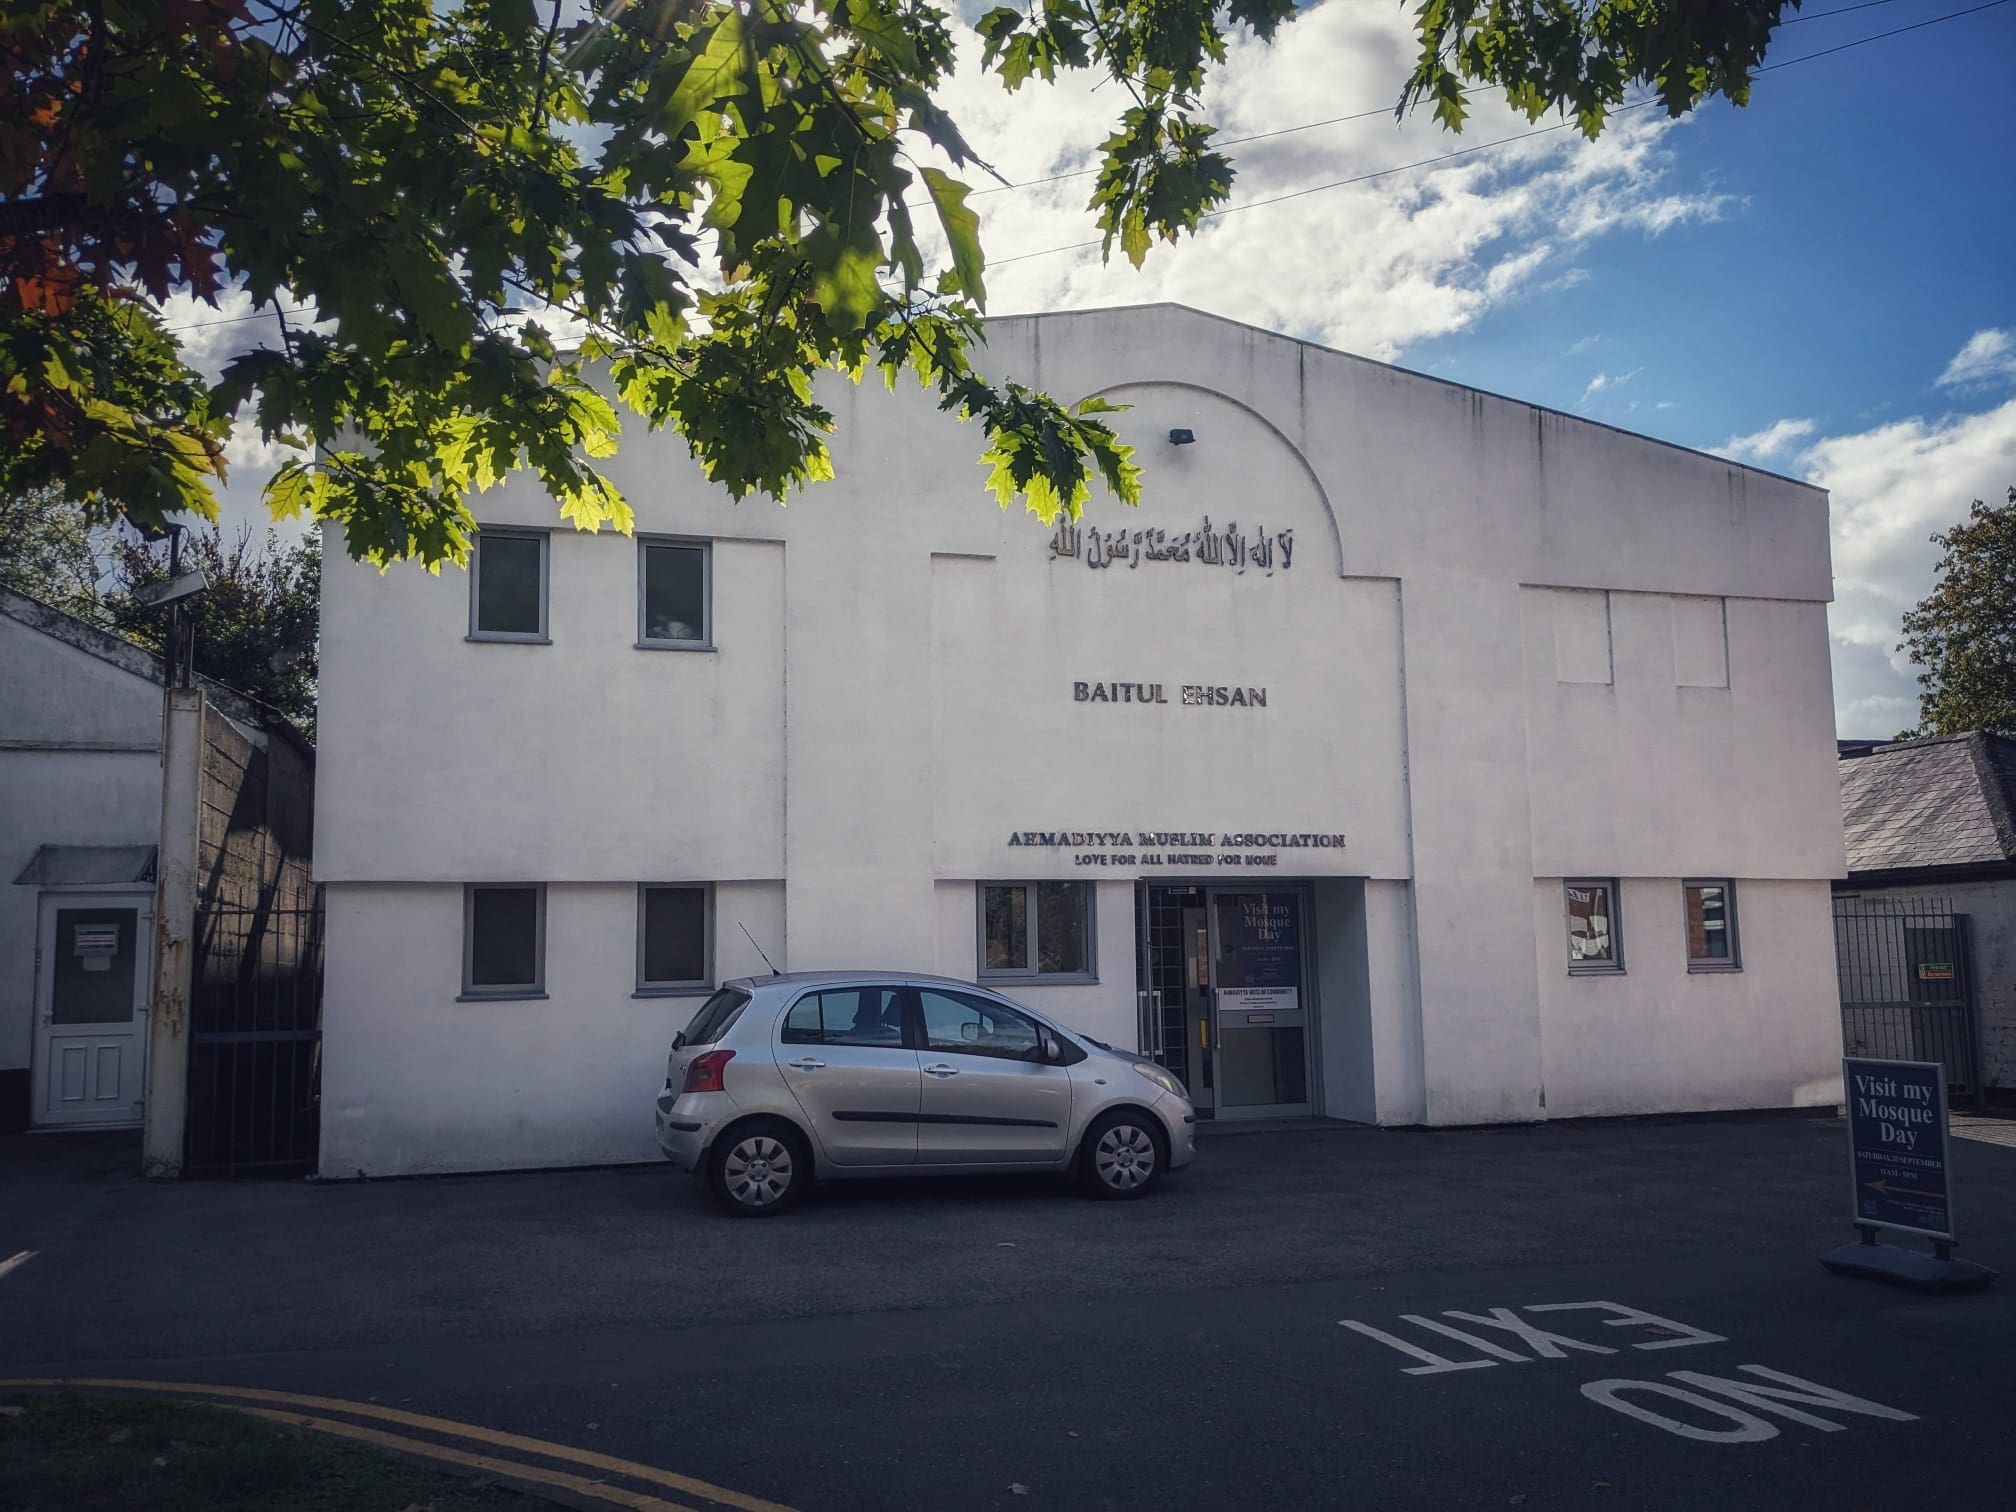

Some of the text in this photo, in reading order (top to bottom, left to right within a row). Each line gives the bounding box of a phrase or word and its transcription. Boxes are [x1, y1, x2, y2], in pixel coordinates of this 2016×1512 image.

[1073, 681, 1268, 708] BAITUL EHSAN
[1008, 831, 1346, 848] AHMADIYYA MUSLIM ASSOCIATION
[1075, 853, 1278, 866] LOVE FOR ALL HATRED FOR NONE
[1243, 903, 1290, 916] Visit my
[1244, 915, 1290, 930] Mosque
[1258, 928, 1282, 943] Day
[1855, 1075, 1933, 1106] Visit my
[1859, 1097, 1934, 1127] Mosque
[1880, 1122, 1918, 1151] Day
[1337, 1300, 1730, 1375] EXIT
[1580, 1363, 1922, 1443] NO
